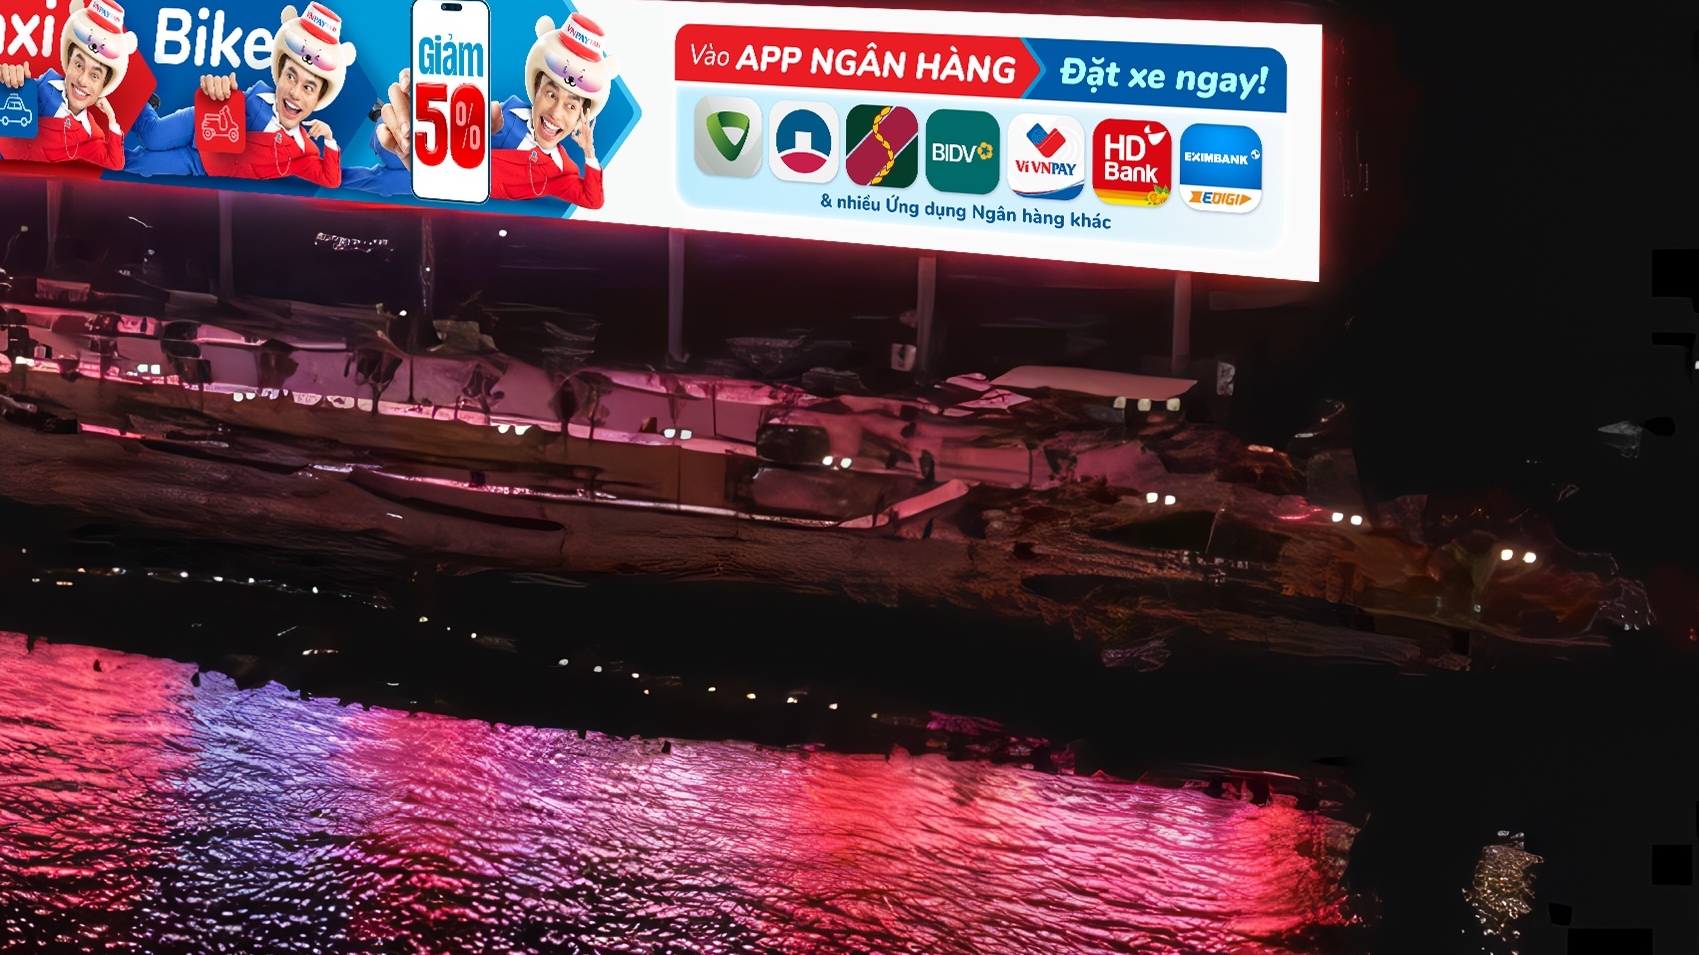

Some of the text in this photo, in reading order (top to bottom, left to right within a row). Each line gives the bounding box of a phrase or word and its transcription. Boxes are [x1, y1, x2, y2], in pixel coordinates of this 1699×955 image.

[154, 7, 273, 70] Bike
[418, 34, 484, 78] Giảm
[690, 42, 1016, 85] Vào APP NGÂN HÀNG
[1060, 56, 1270, 101] Đặt xe ngay!
[932, 142, 978, 164] BIDV
[1104, 134, 1146, 162] HD
[1184, 151, 1249, 166] EXIMBANK
[1032, 160, 1077, 176] VNPAY
[1104, 162, 1159, 184] Bank
[820, 193, 1112, 230] & nhiều Ứng dụng Ngân hàng khác
[1202, 191, 1241, 206] EDIGI
